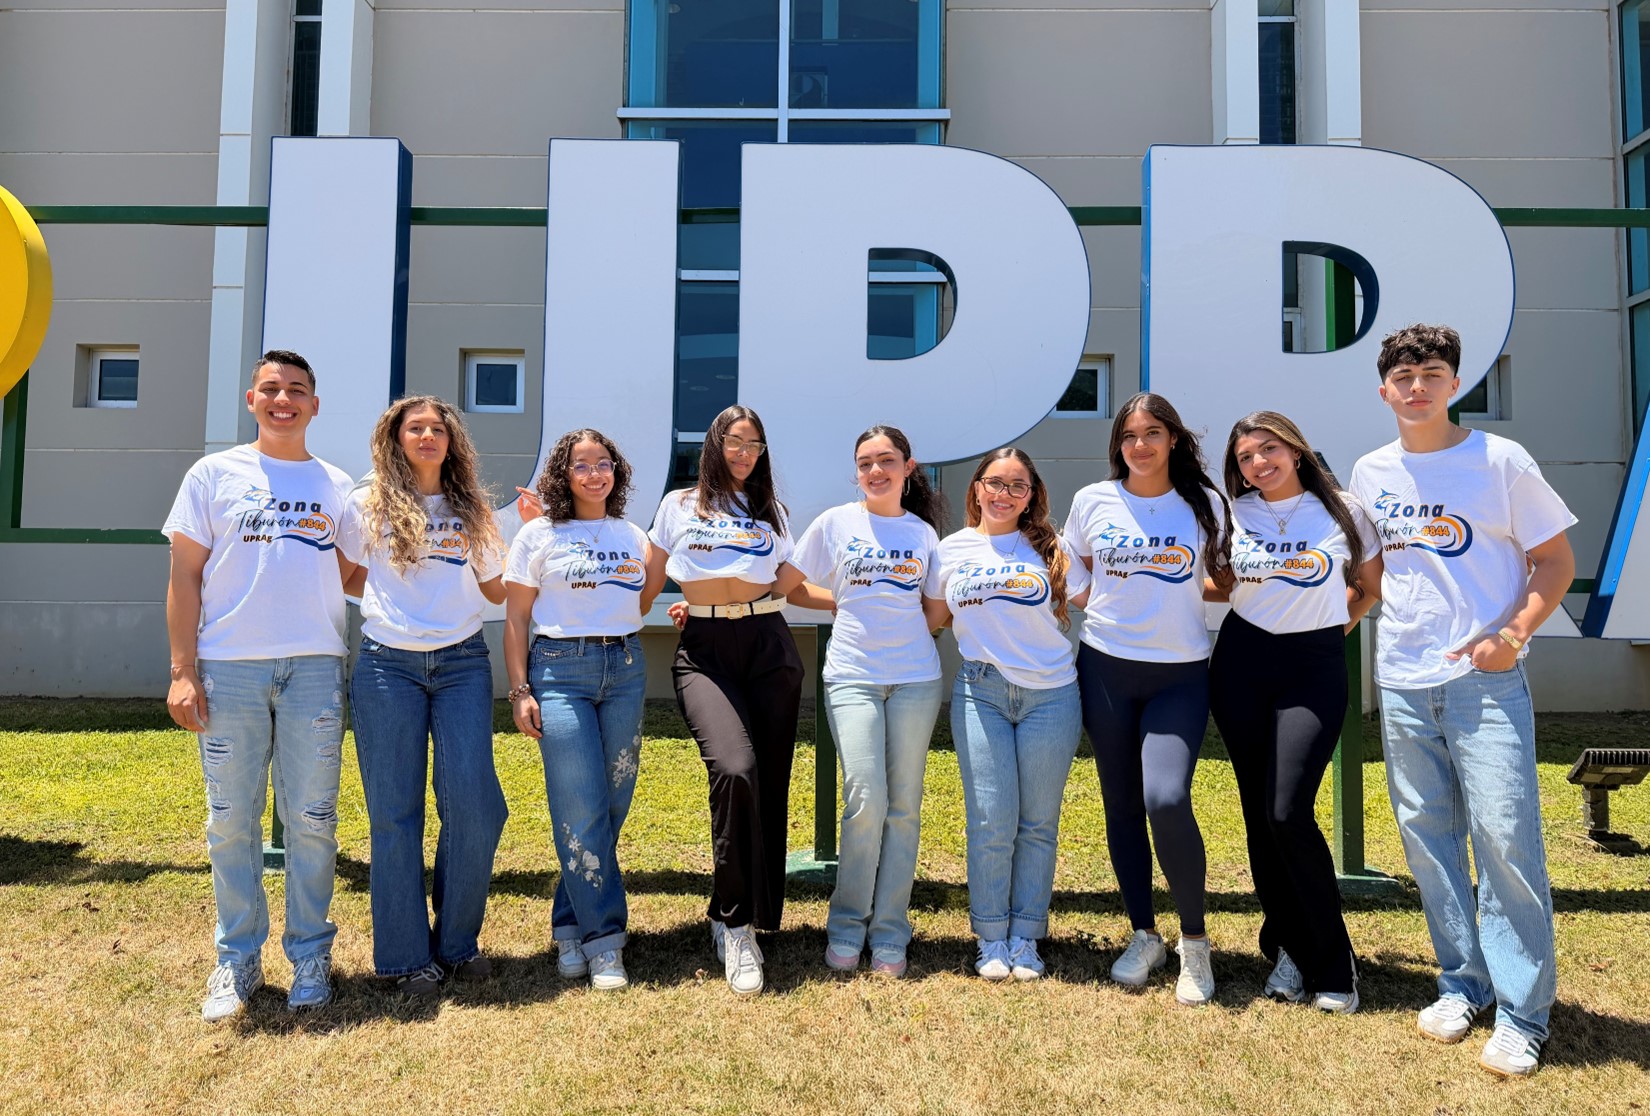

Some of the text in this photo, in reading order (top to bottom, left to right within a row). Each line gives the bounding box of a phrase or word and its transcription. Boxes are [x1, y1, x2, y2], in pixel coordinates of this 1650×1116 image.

[263, 497, 322, 513] Zona
[1388, 502, 1445, 518] Zona
[298, 518, 327, 531] #844
[425, 521, 463, 533] ona
[1421, 525, 1451, 537] #844
[1116, 535, 1177, 549] Zona
[1250, 539, 1308, 553] Zona
[585, 549, 631, 562] Zona
[863, 547, 914, 559] Zona
[1151, 553, 1182, 565] #844
[615, 564, 640, 574] #844
[892, 564, 917, 575] #844
[1284, 558, 1315, 570] #844
[971, 564, 1026, 577] Zona
[1004, 578, 1034, 589] #844
